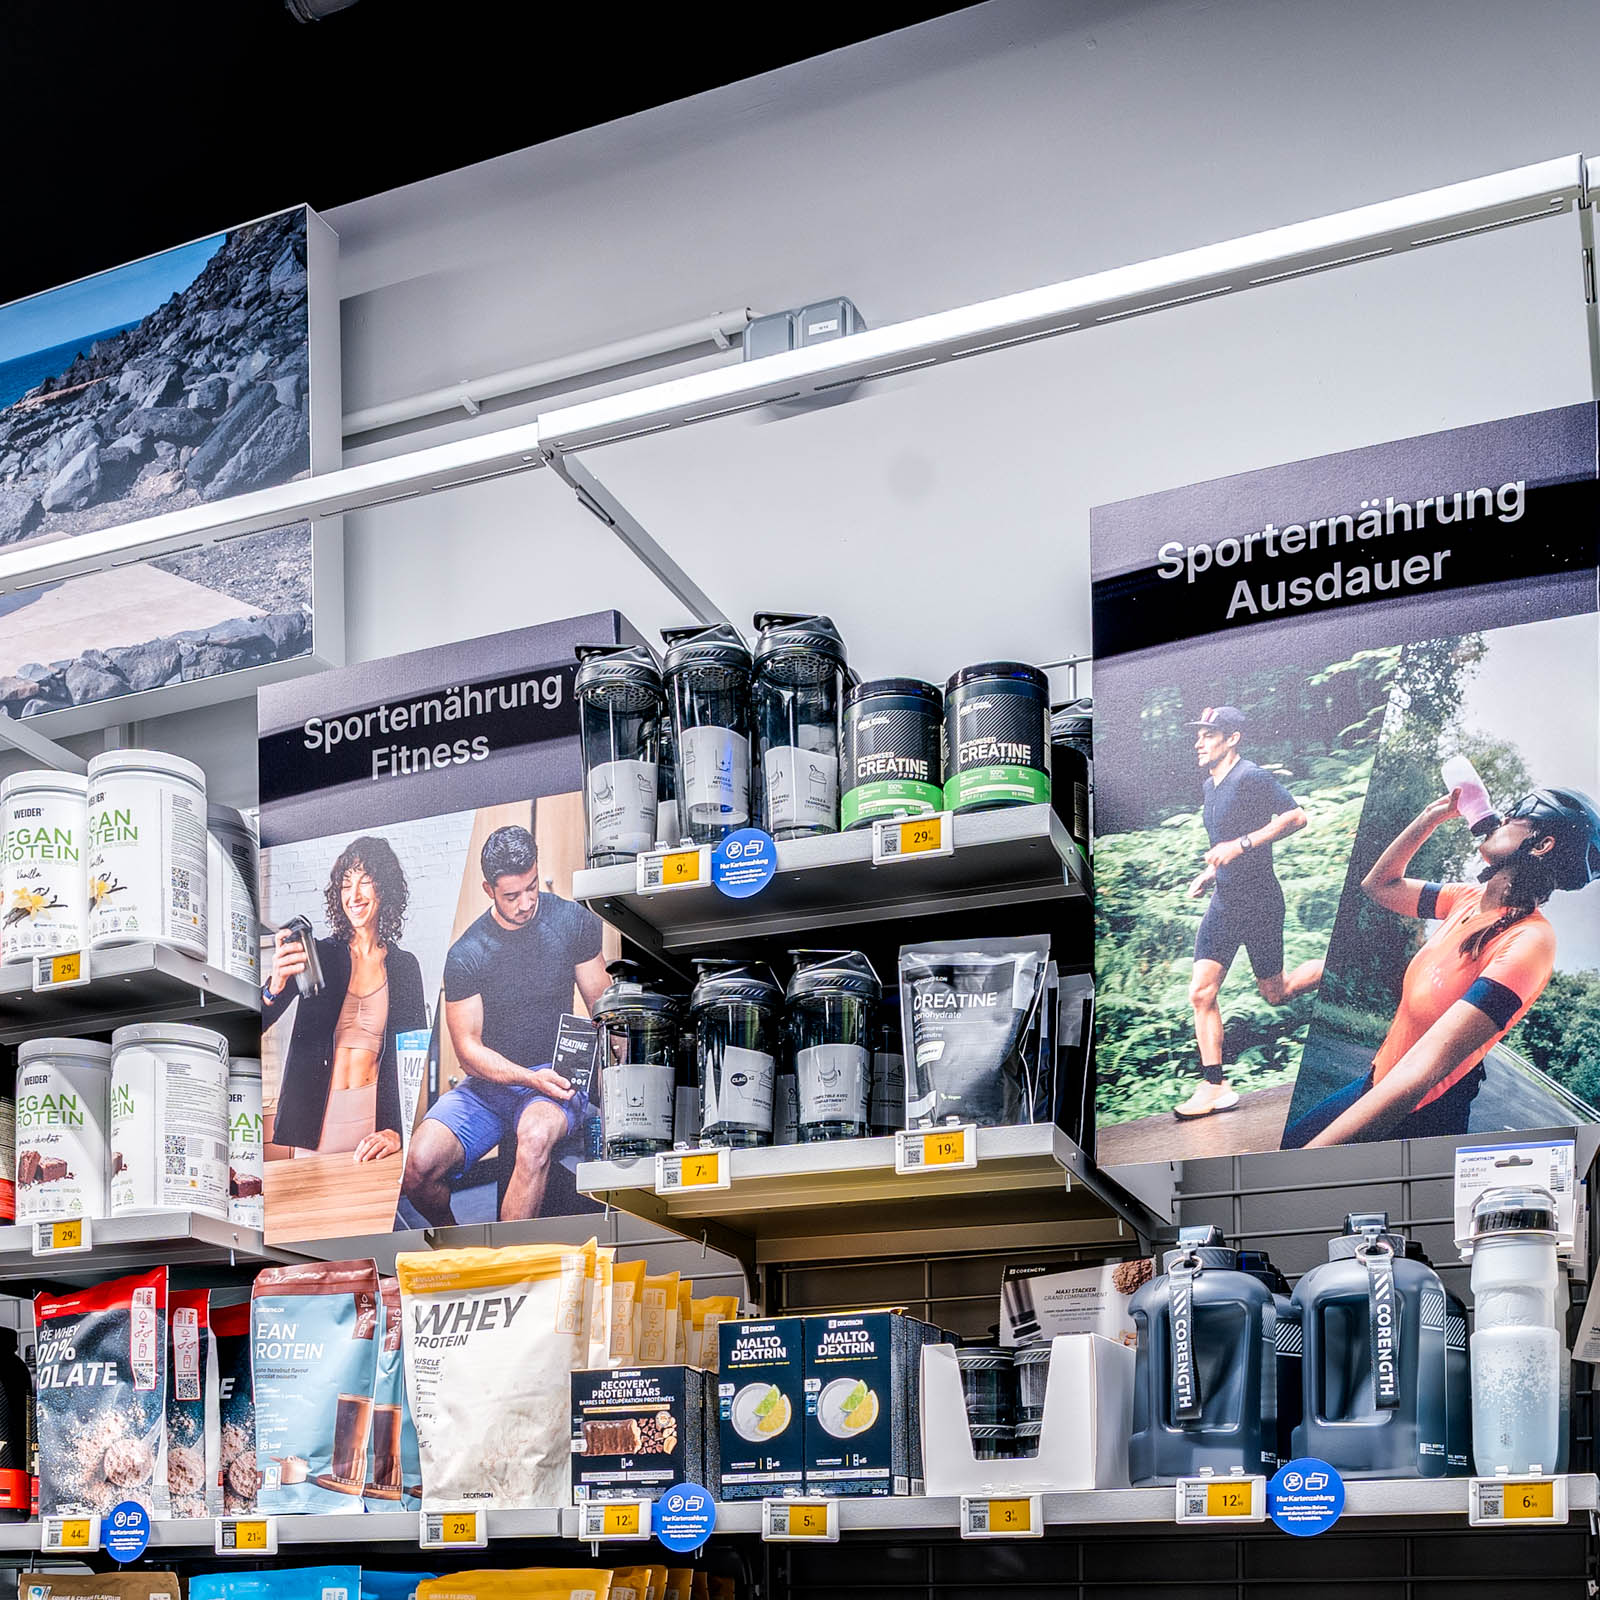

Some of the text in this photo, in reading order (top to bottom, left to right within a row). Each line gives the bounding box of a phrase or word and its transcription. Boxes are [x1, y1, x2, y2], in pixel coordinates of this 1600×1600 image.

[1156, 480, 1526, 583] Sporternährung
[1226, 550, 1451, 619] Ausdauer
[304, 675, 562, 753] Sporternährung
[372, 735, 490, 780] Fitness
[858, 757, 929, 778] CREATINE
[959, 741, 1032, 765] CREATINE
[412, 1294, 525, 1336] WHEY
[414, 1332, 469, 1349] PROTEIN
[816, 1341, 875, 1356] DEXTRIN
[822, 1331, 870, 1345] MALTO
[1376, 1304, 1395, 1396] CORENGTH
[1176, 1318, 1192, 1409] CORENGTH
